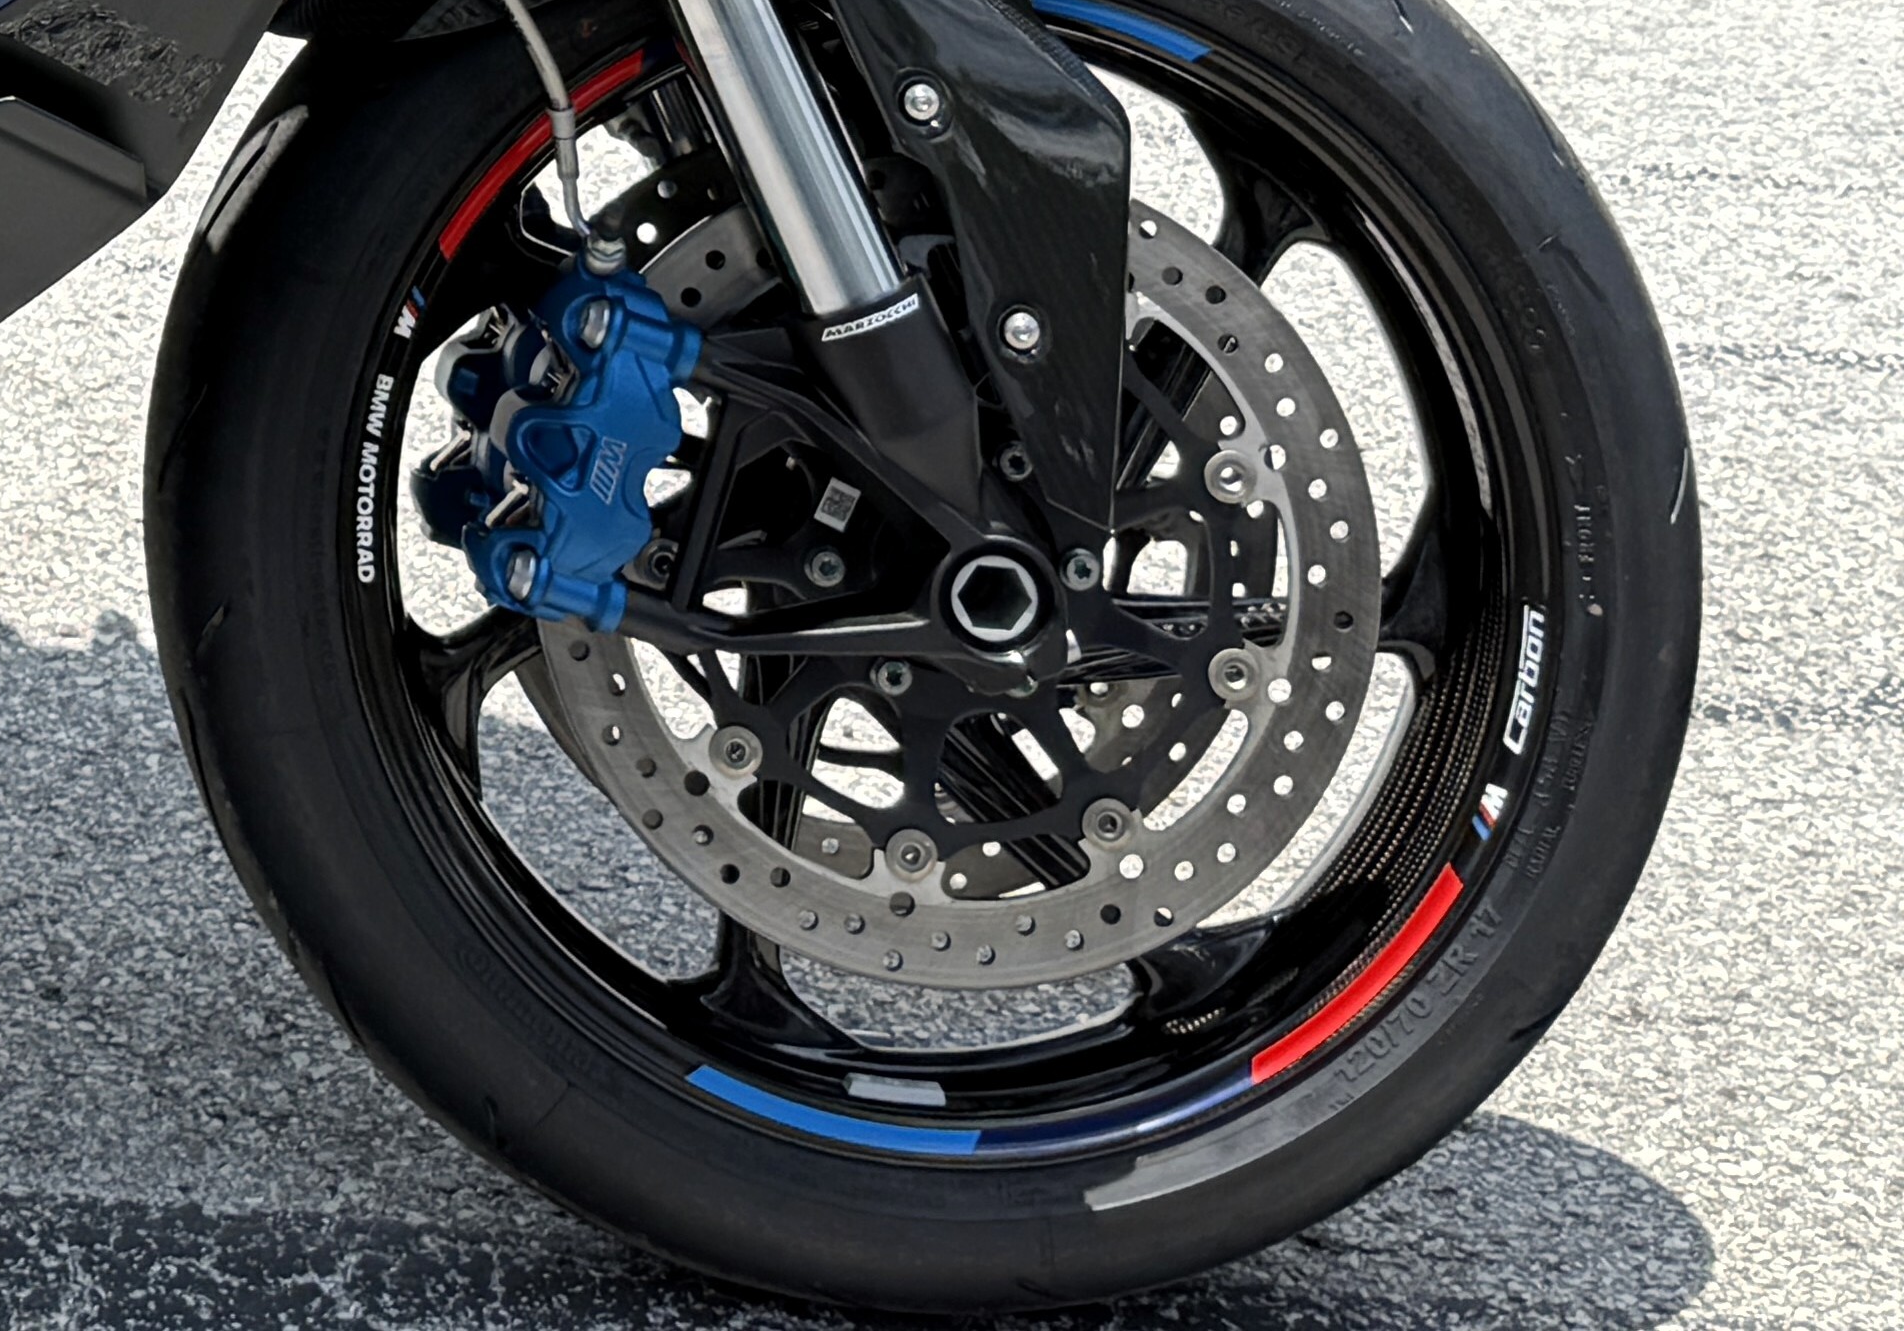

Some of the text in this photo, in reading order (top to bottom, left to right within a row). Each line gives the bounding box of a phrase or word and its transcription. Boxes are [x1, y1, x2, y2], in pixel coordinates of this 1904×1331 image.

[356, 373, 394, 584] BMW MOTORRAD
[1502, 604, 1546, 755] Carbon
